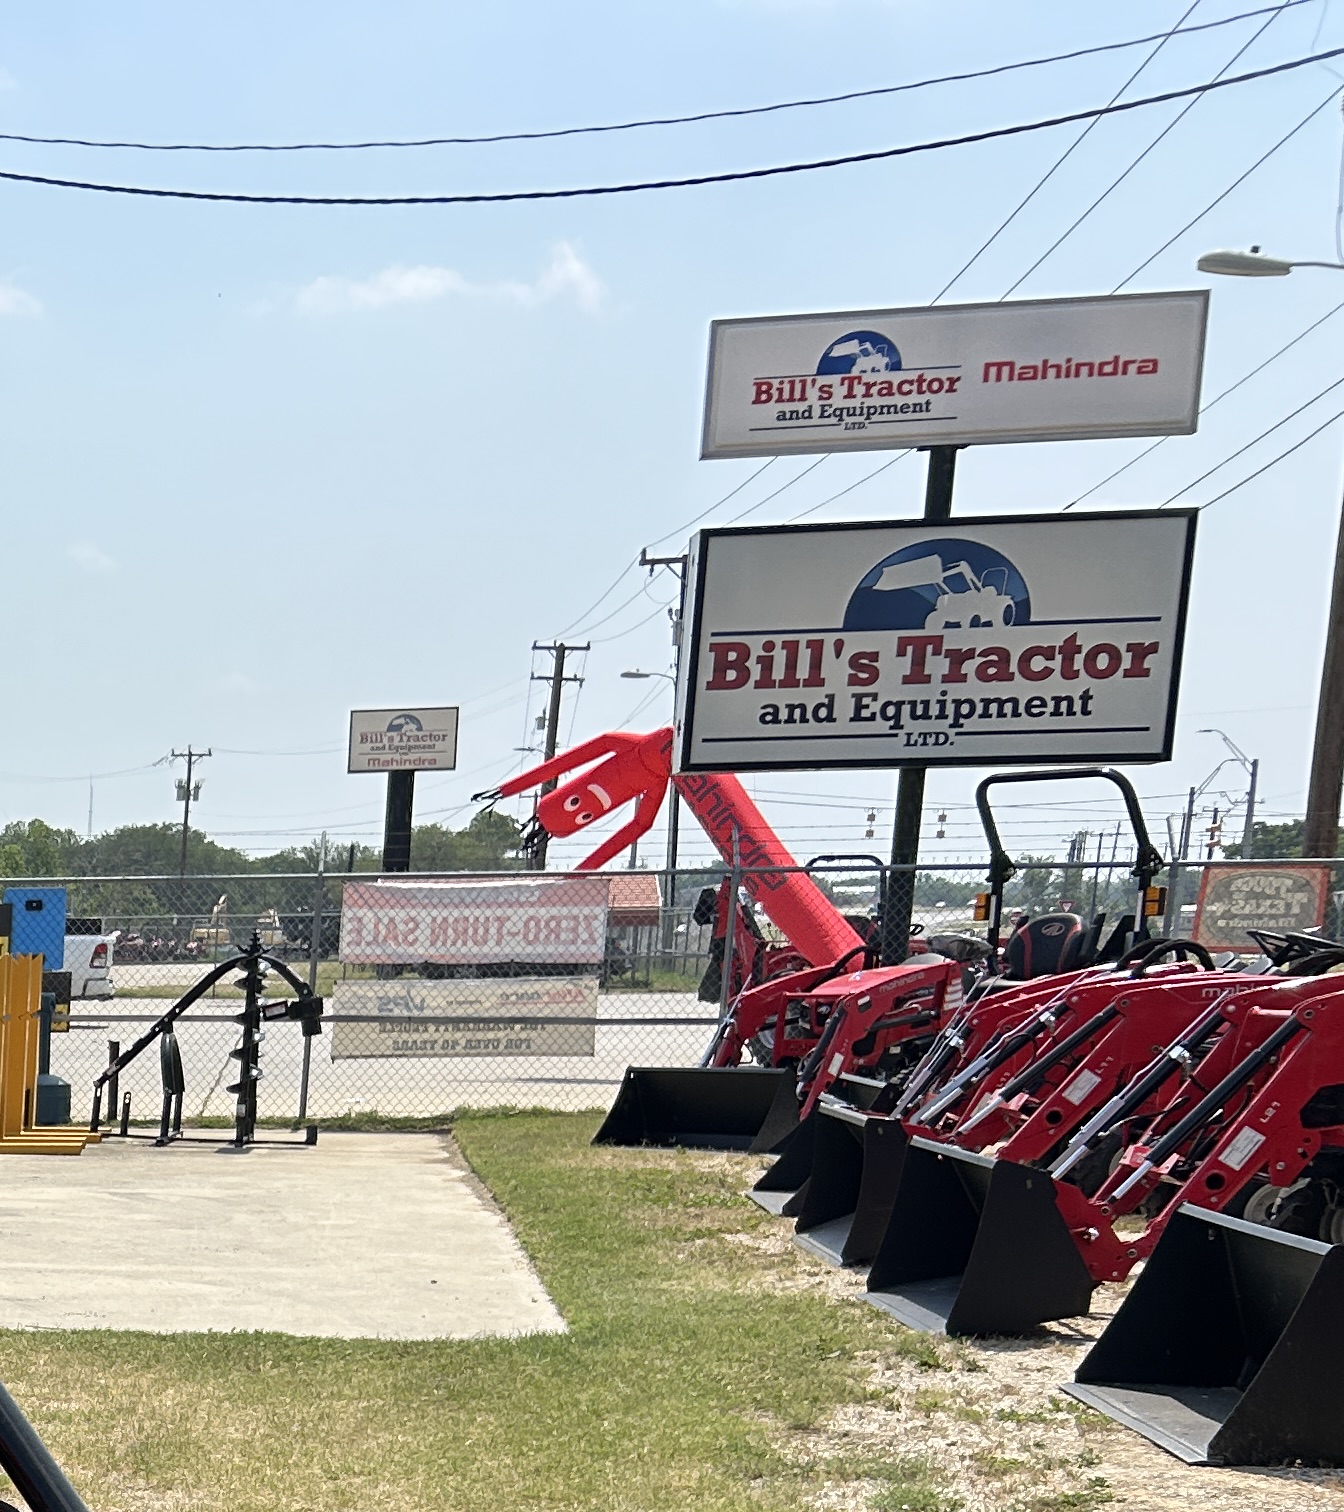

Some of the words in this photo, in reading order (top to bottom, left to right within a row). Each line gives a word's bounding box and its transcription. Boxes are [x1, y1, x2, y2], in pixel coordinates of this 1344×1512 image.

[982, 354, 1160, 384] Mahindra
[751, 376, 834, 405] Bill's
[840, 374, 962, 400] Tractor
[775, 404, 813, 421] and
[818, 399, 932, 423] Equipment
[705, 638, 881, 691] Bill's
[896, 631, 1159, 686] Tractor
[758, 693, 837, 725] and
[849, 685, 1094, 729] Equipment
[359, 732, 395, 744] Bill's
[396, 731, 449, 743] Tractor
[370, 744, 386, 752] and
[388, 743, 436, 753] Equipment
[903, 731, 955, 747] LTD.
